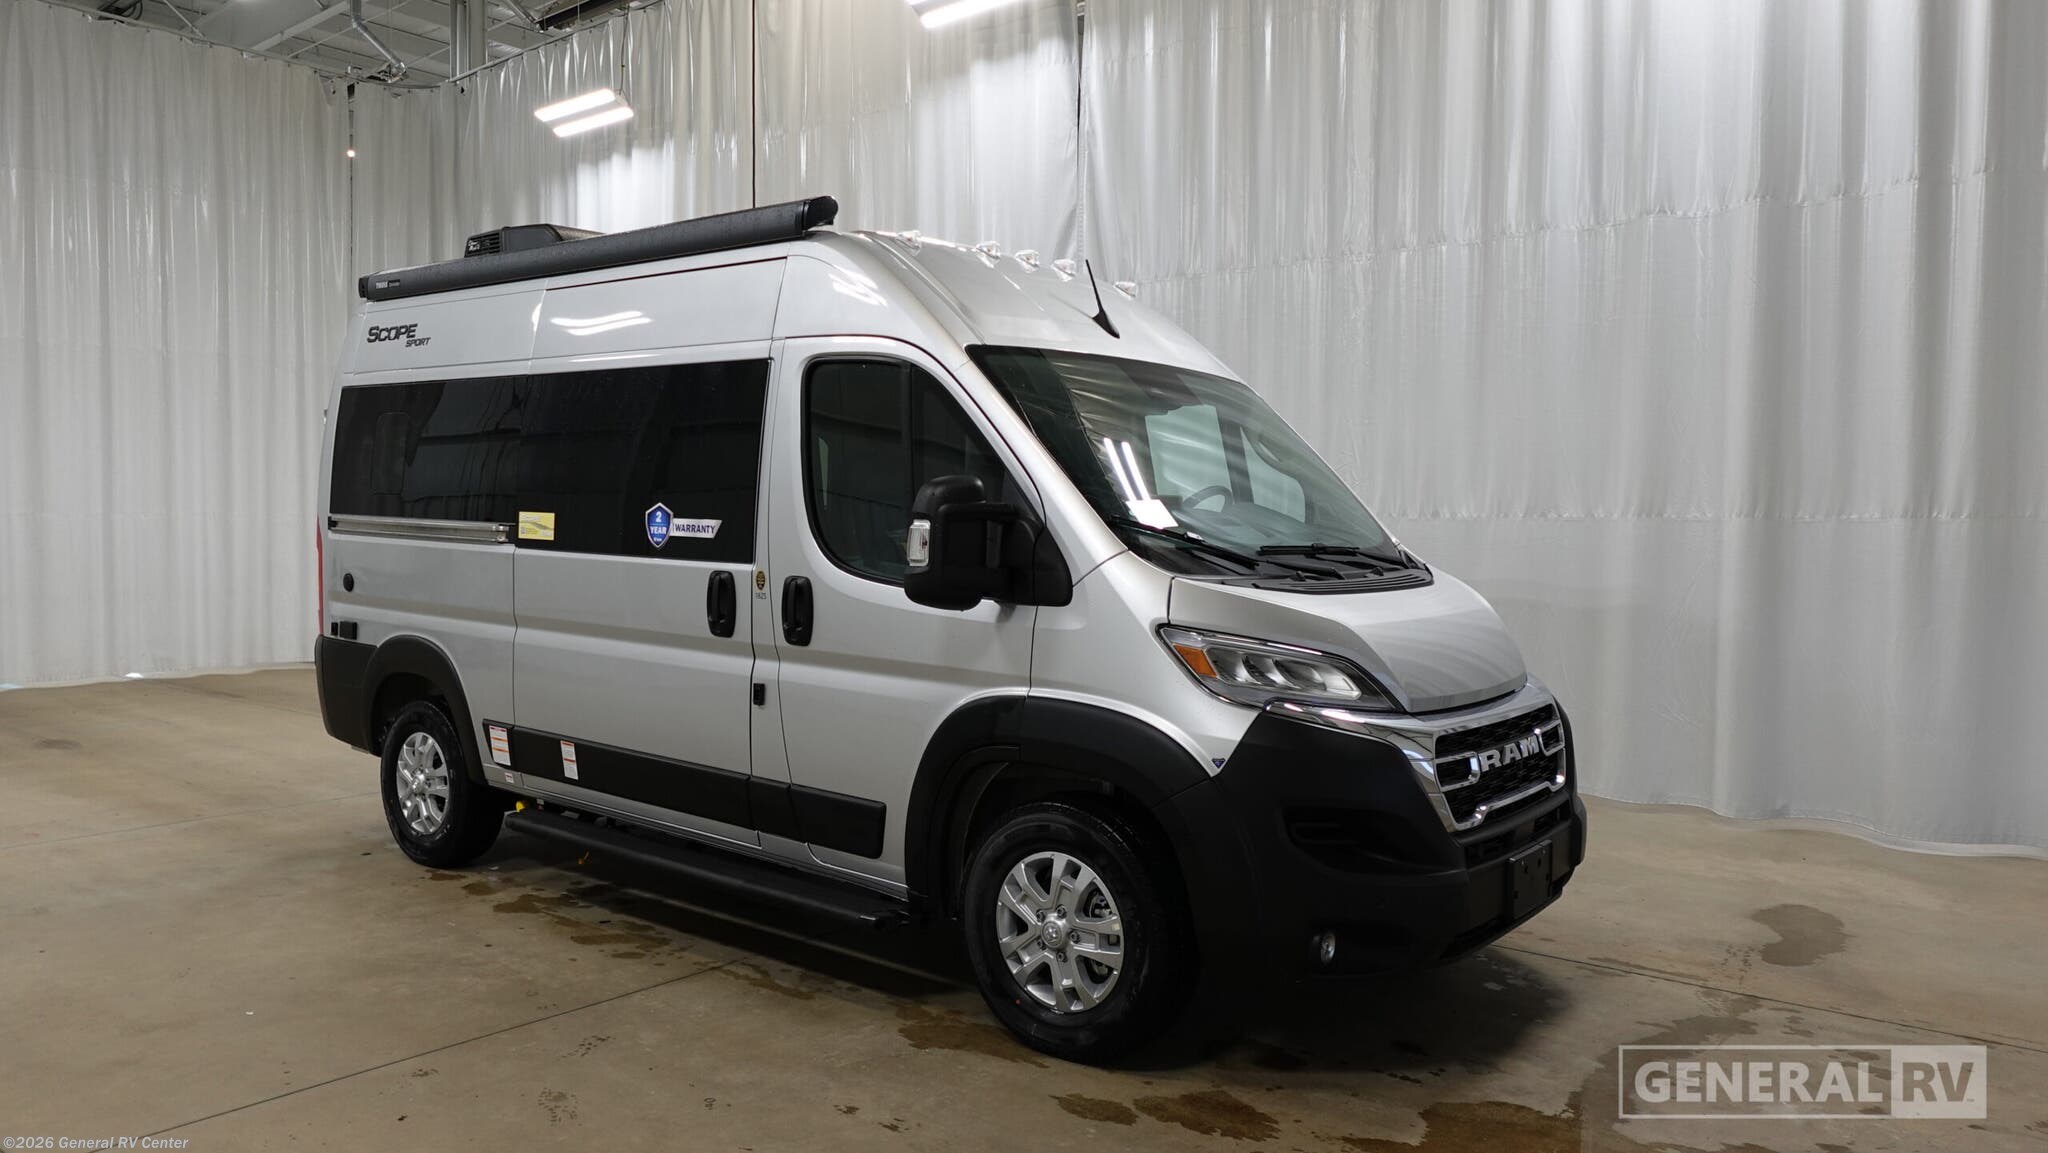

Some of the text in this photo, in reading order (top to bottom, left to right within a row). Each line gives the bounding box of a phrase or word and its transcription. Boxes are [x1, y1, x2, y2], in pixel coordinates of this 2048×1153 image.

[367, 323, 418, 343] SCOPE
[405, 337, 431, 347] SPORT
[655, 511, 662, 523] 2
[650, 526, 667, 535] YEAR
[675, 523, 716, 534] WARRANTY
[1478, 735, 1540, 772] RAM
